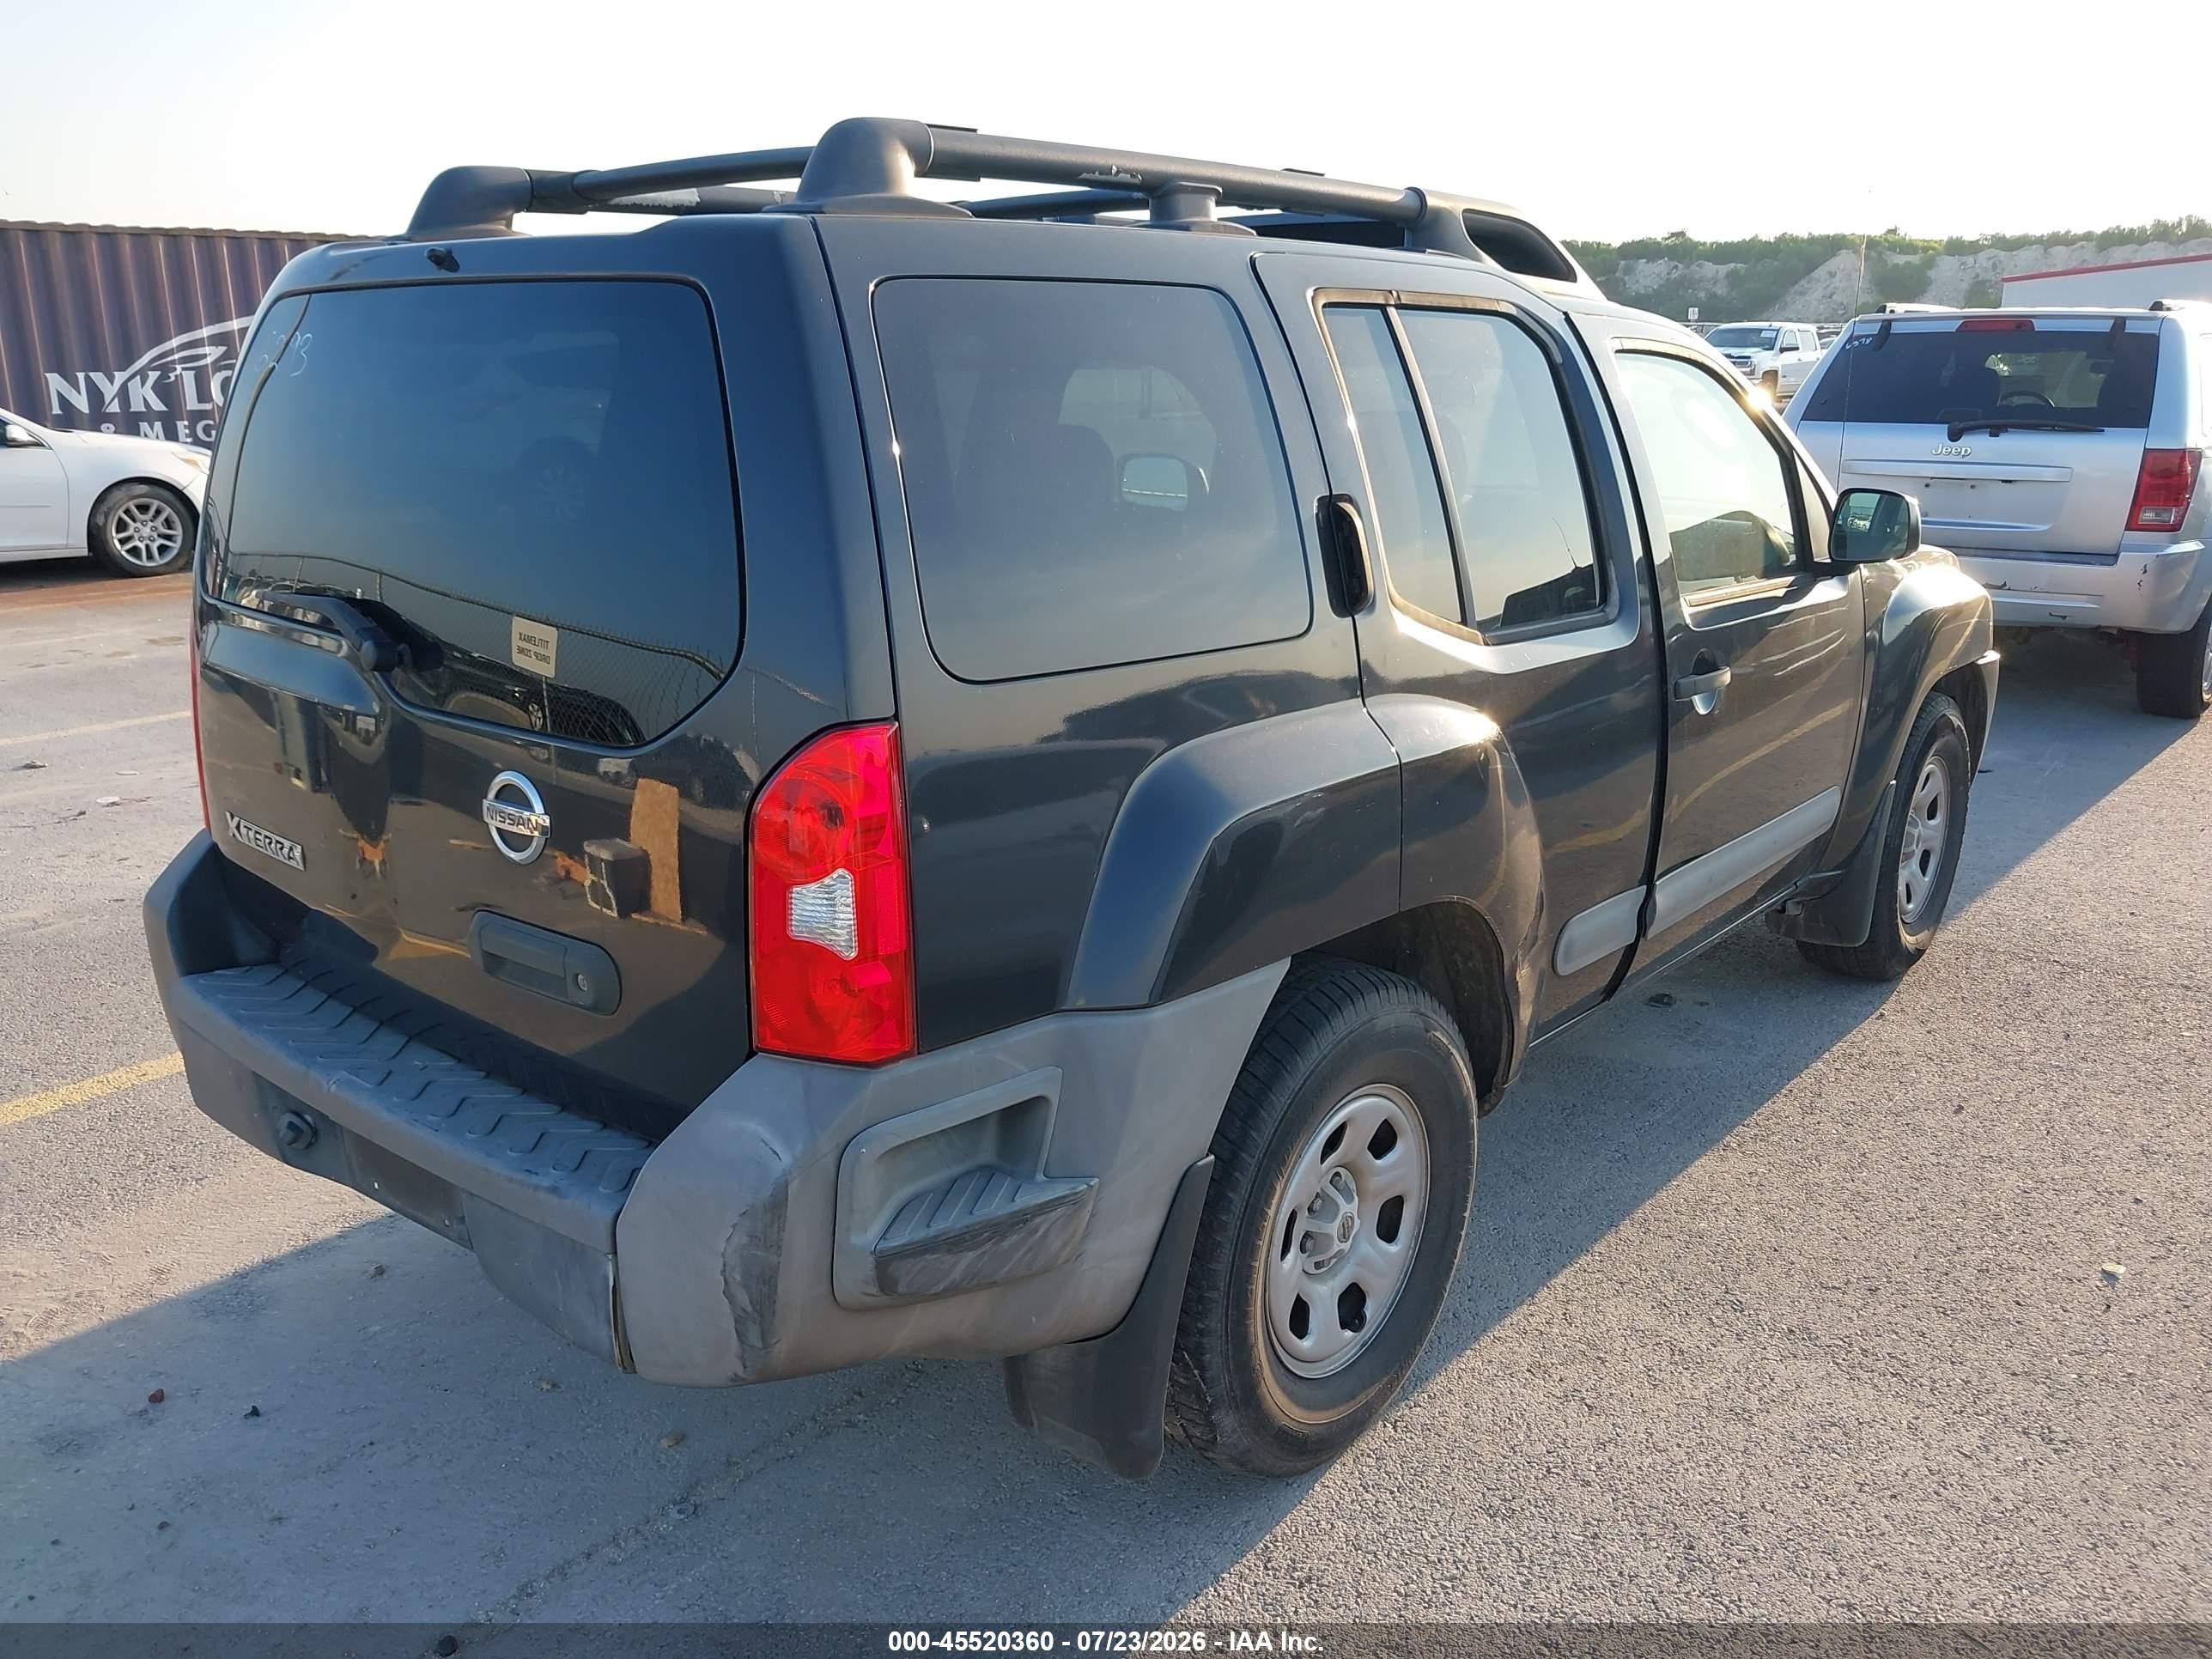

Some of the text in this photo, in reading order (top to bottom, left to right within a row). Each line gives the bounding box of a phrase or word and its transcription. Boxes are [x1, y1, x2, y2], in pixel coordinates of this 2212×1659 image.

[45, 370, 169, 414] NYK
[1931, 443, 1972, 459] Jeep
[485, 805, 539, 832] NISSAN
[225, 811, 303, 868] XTERRA
